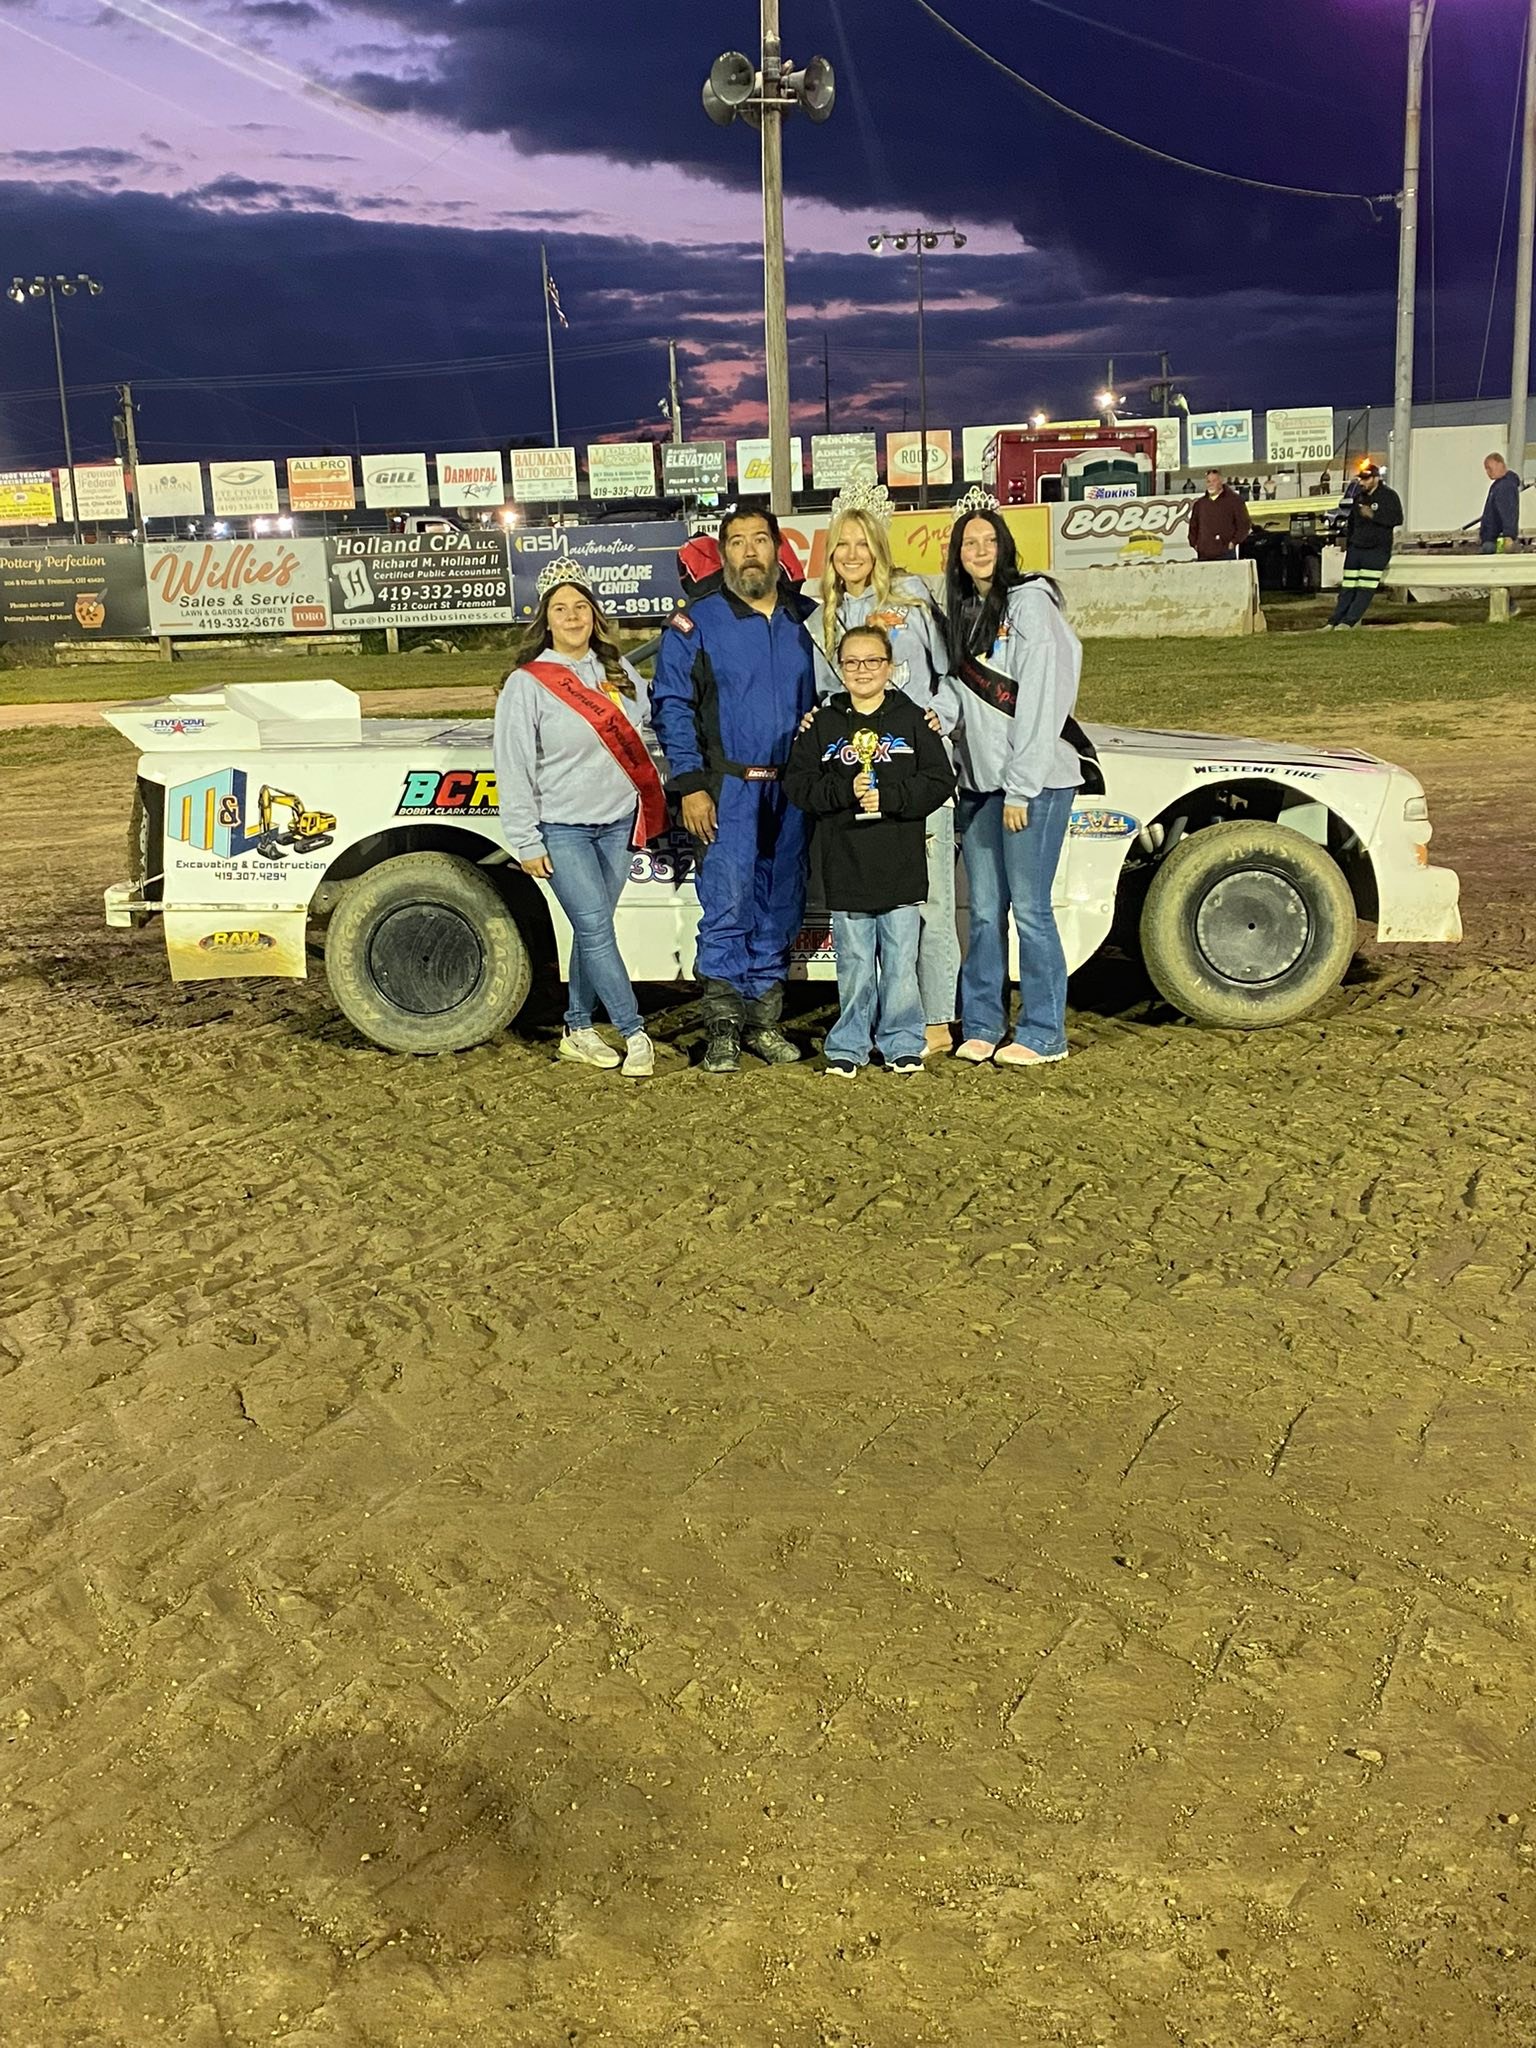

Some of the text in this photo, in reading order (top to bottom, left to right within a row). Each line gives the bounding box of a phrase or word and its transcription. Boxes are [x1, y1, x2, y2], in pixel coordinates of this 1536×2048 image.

[515, 452, 571, 467] BAUMANN
[901, 448, 939, 464] ROOS
[1270, 445, 1331, 460] 334-7800
[294, 460, 346, 470] ALL PRO
[665, 452, 722, 468] ELEVATION
[375, 471, 417, 484] GILL
[443, 464, 498, 484] DARMOFAL
[516, 466, 573, 479] AUTO GROUP
[81, 478, 116, 488] Federal
[234, 488, 274, 497] CENTERS
[592, 485, 653, 497] 419-332-0727
[336, 534, 498, 555] Holland CPA LLC.
[522, 529, 636, 557] ash automotive
[0, 554, 107, 573] Pottery Perfection
[372, 557, 418, 570] Richard
[422, 557, 436, 567] M.
[440, 555, 487, 567] Holland
[150, 544, 300, 604] Willie's
[373, 568, 501, 580] Certified Public Accountant
[377, 581, 507, 602] 419-332-9808
[598, 581, 639, 595] CENTER
[179, 592, 315, 608] Sales & Service
[390, 599, 497, 611] 512 Court St Fremont
[211, 608, 243, 616] GARDEN
[244, 607, 287, 615] EQUIPMENT
[294, 612, 323, 622] TORO
[198, 617, 285, 629] 419-332-3676
[1193, 766, 1326, 780] WESTEND TIRE
[400, 771, 499, 807] BCR
[218, 795, 241, 827] &
[398, 807, 500, 815] BOBBY CLARK RACIN
[175, 860, 239, 871] Excavating
[252, 860, 326, 870] Construction
[214, 872, 287, 881] 419.307.4294
[213, 931, 260, 945] RAM
[485, 917, 508, 1006] RACER
